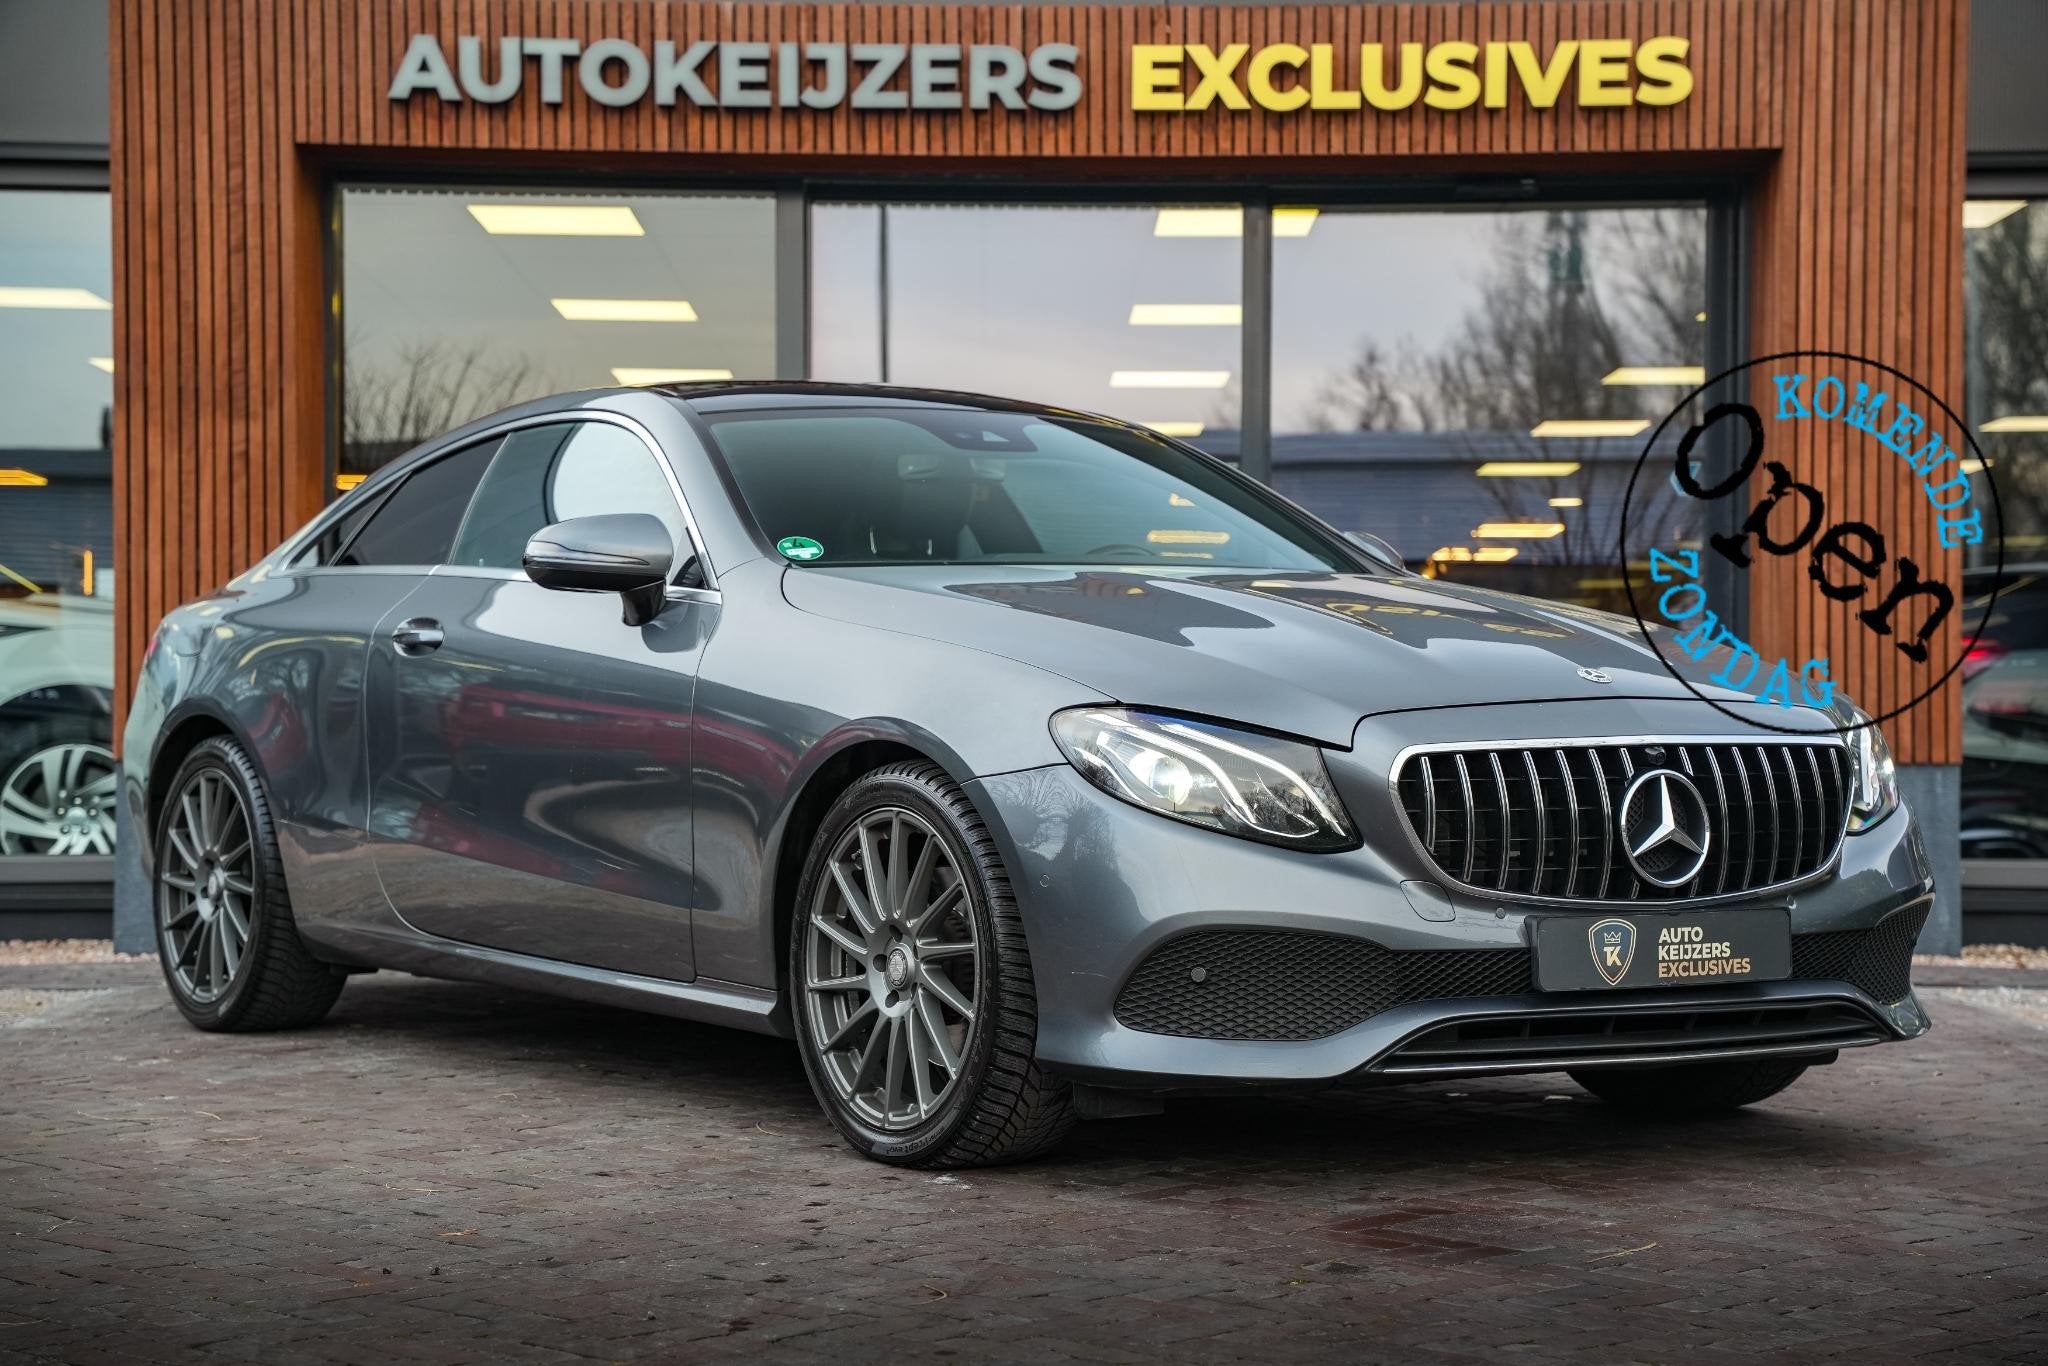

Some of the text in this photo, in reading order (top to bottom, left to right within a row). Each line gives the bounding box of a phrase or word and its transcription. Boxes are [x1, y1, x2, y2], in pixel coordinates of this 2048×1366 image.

[388, 34, 1694, 111] AUTOKEIJZERS EXCLUSIVES
[1658, 926, 1704, 944] AUTO
[1658, 942, 1731, 961] KEIJZERS
[1658, 957, 1751, 978] EXCLUSIVES
